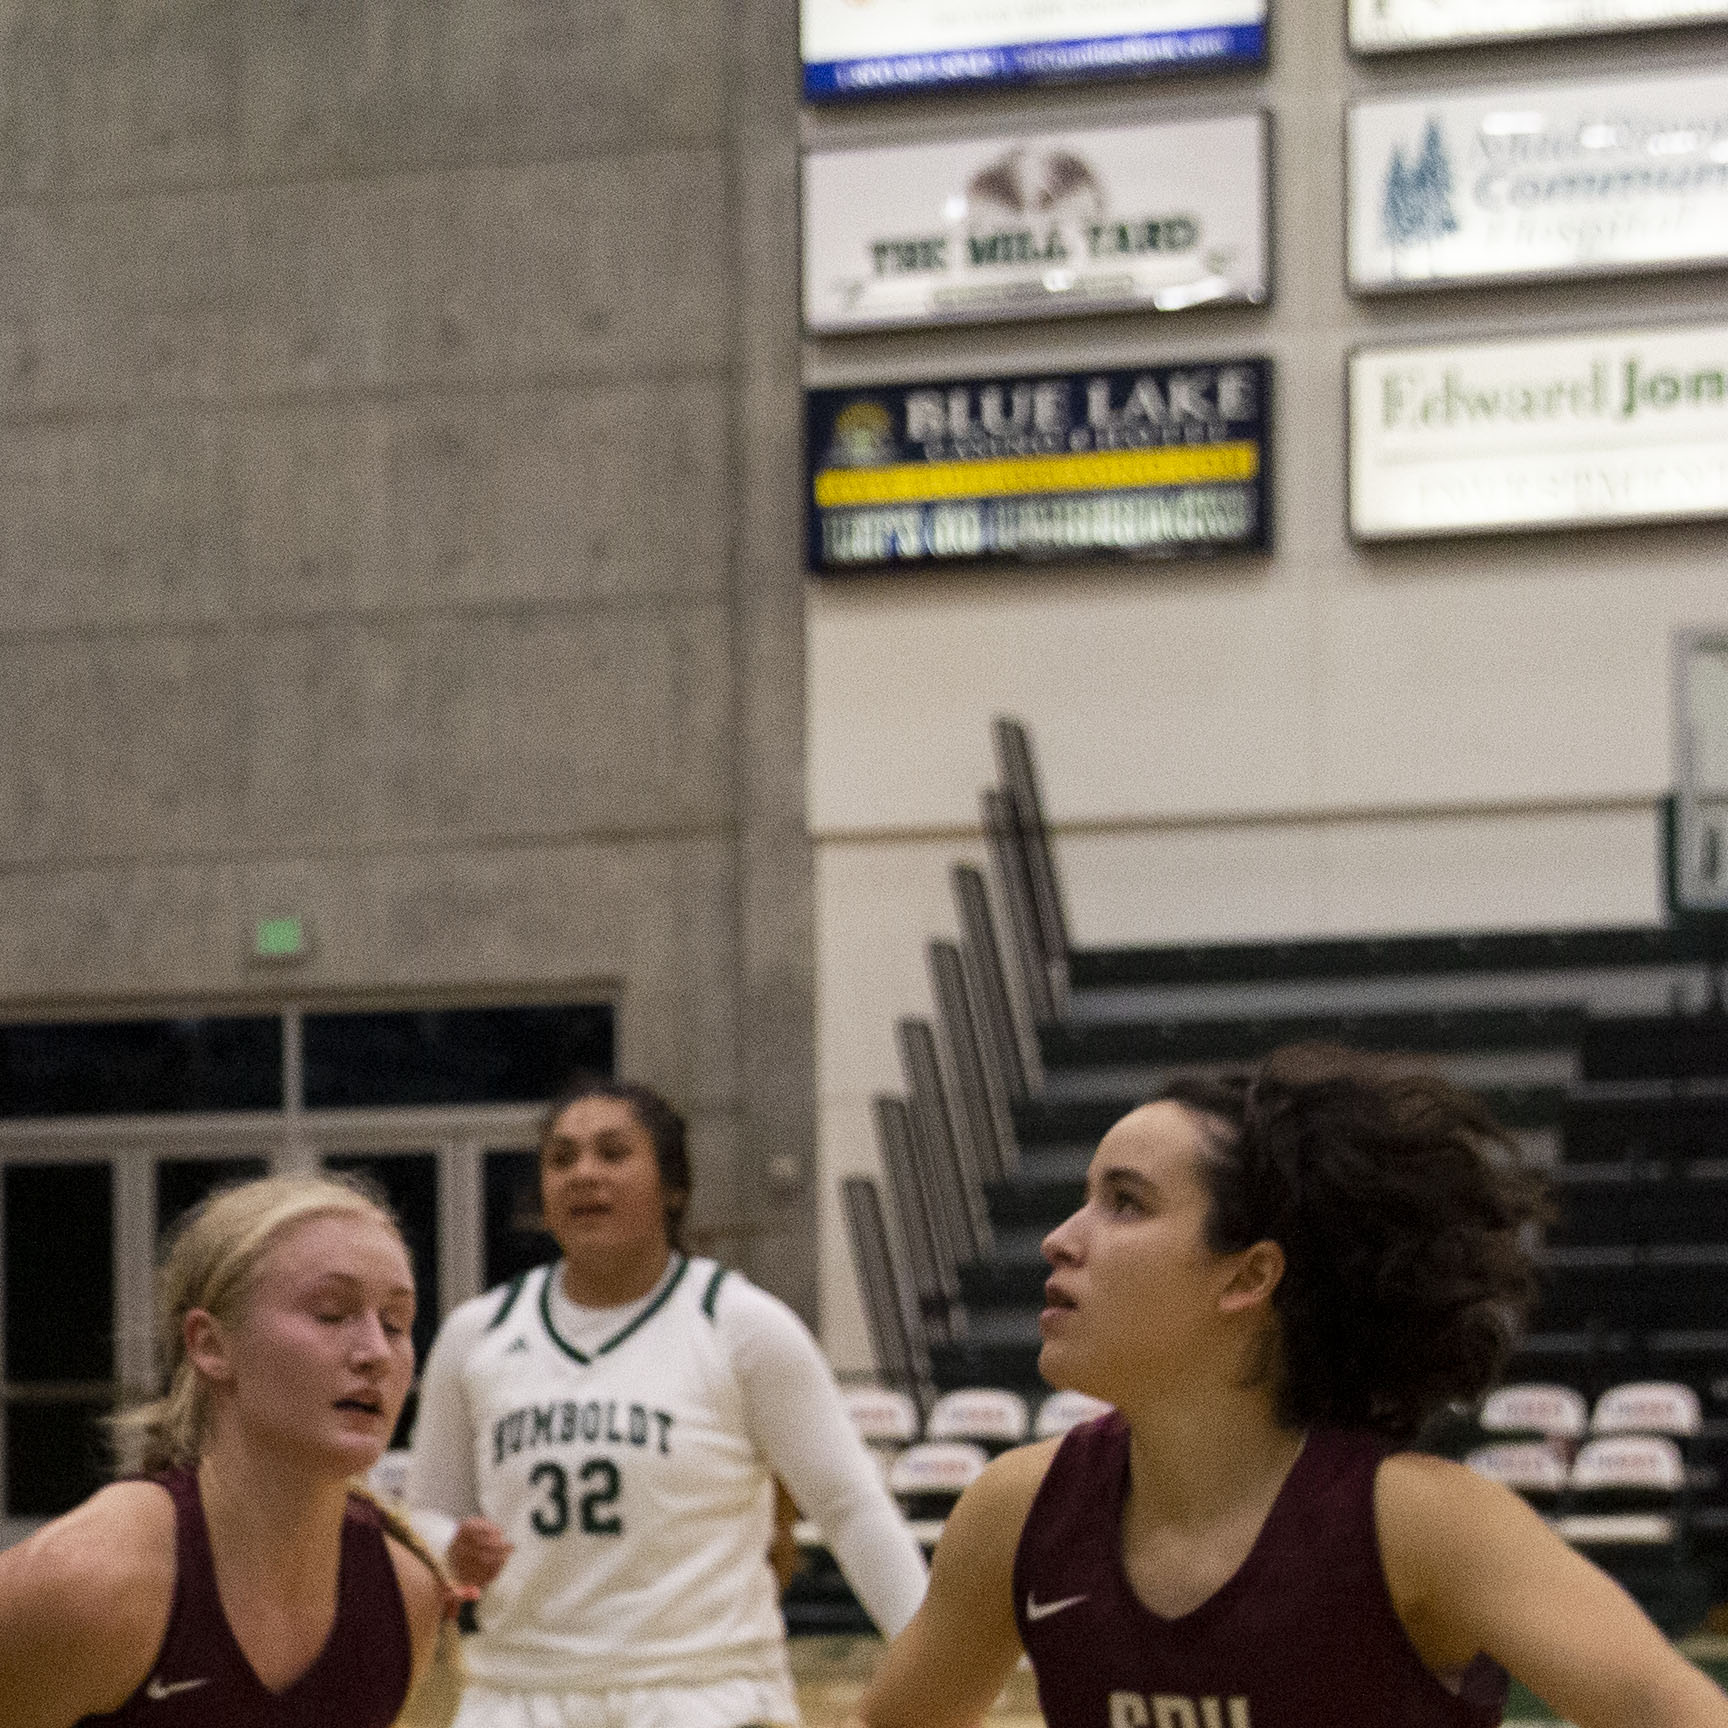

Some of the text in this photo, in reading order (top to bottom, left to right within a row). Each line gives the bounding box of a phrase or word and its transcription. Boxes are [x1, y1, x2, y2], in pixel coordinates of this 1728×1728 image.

[870, 236, 948, 276] THE
[1087, 213, 1202, 256] YARD
[905, 367, 1257, 441] BLUE LAKE
[1381, 358, 1608, 430] Edward
[493, 1399, 675, 1465] HUMBOLDT
[528, 1457, 623, 1538] 32
